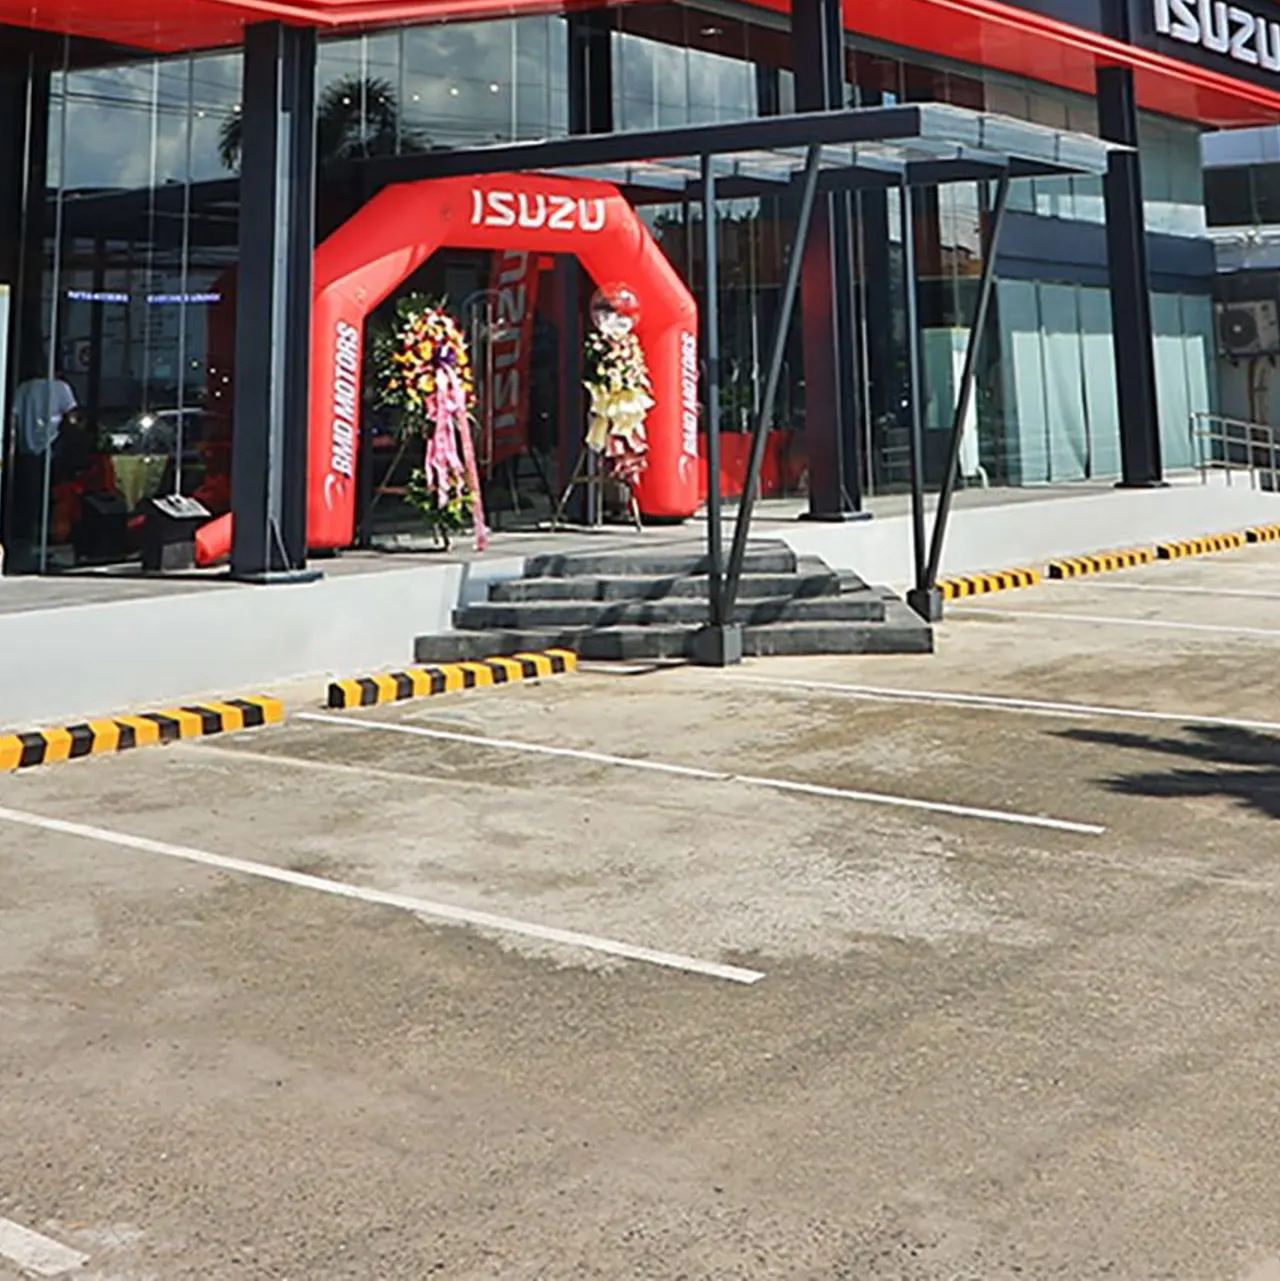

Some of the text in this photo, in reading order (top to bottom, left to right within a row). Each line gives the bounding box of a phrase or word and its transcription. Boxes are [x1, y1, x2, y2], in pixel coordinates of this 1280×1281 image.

[471, 189, 605, 232] ISUZU
[333, 320, 359, 423] MOTORS
[493, 249, 529, 428] ISUZU
[681, 331, 699, 415] MOTORS
